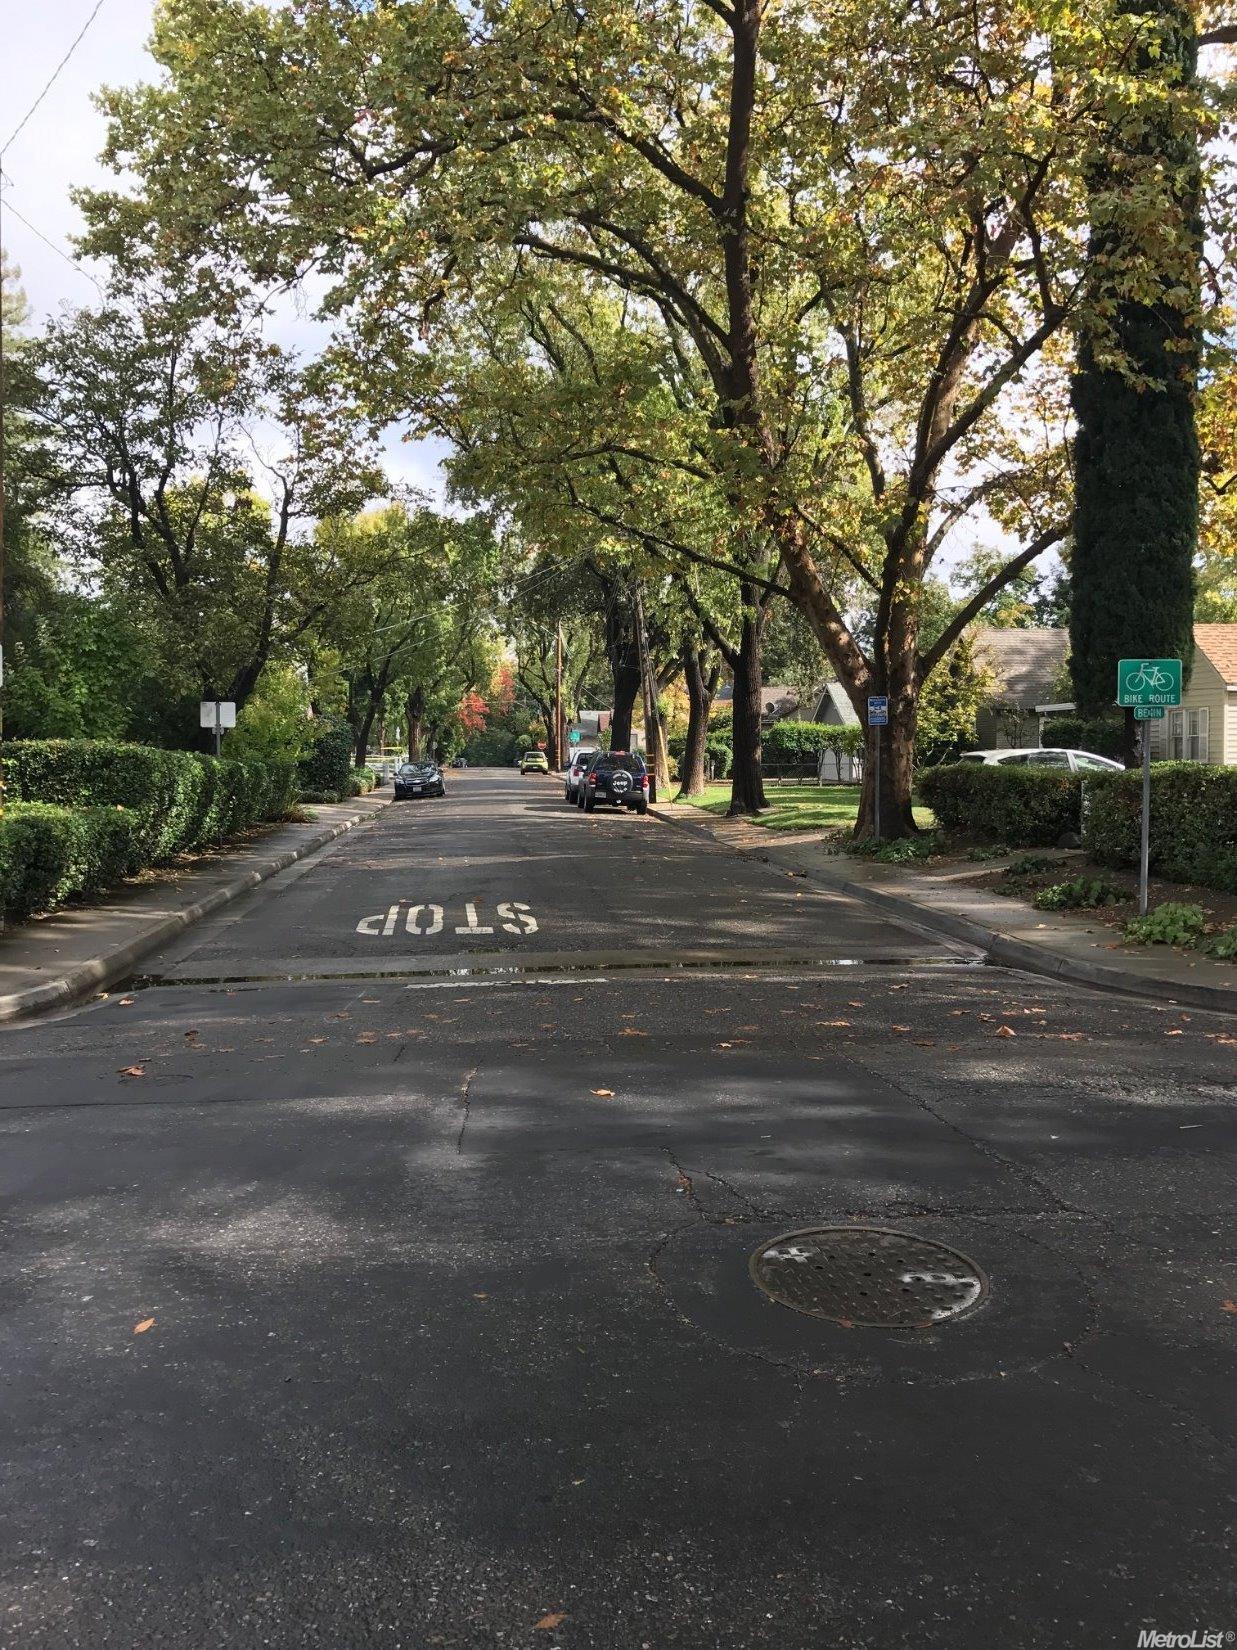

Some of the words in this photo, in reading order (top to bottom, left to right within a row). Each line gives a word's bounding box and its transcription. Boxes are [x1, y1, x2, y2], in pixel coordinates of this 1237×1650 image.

[1124, 694, 1143, 704] BIKE
[1149, 694, 1176, 704] ROUTE
[356, 902, 539, 935] STOP
